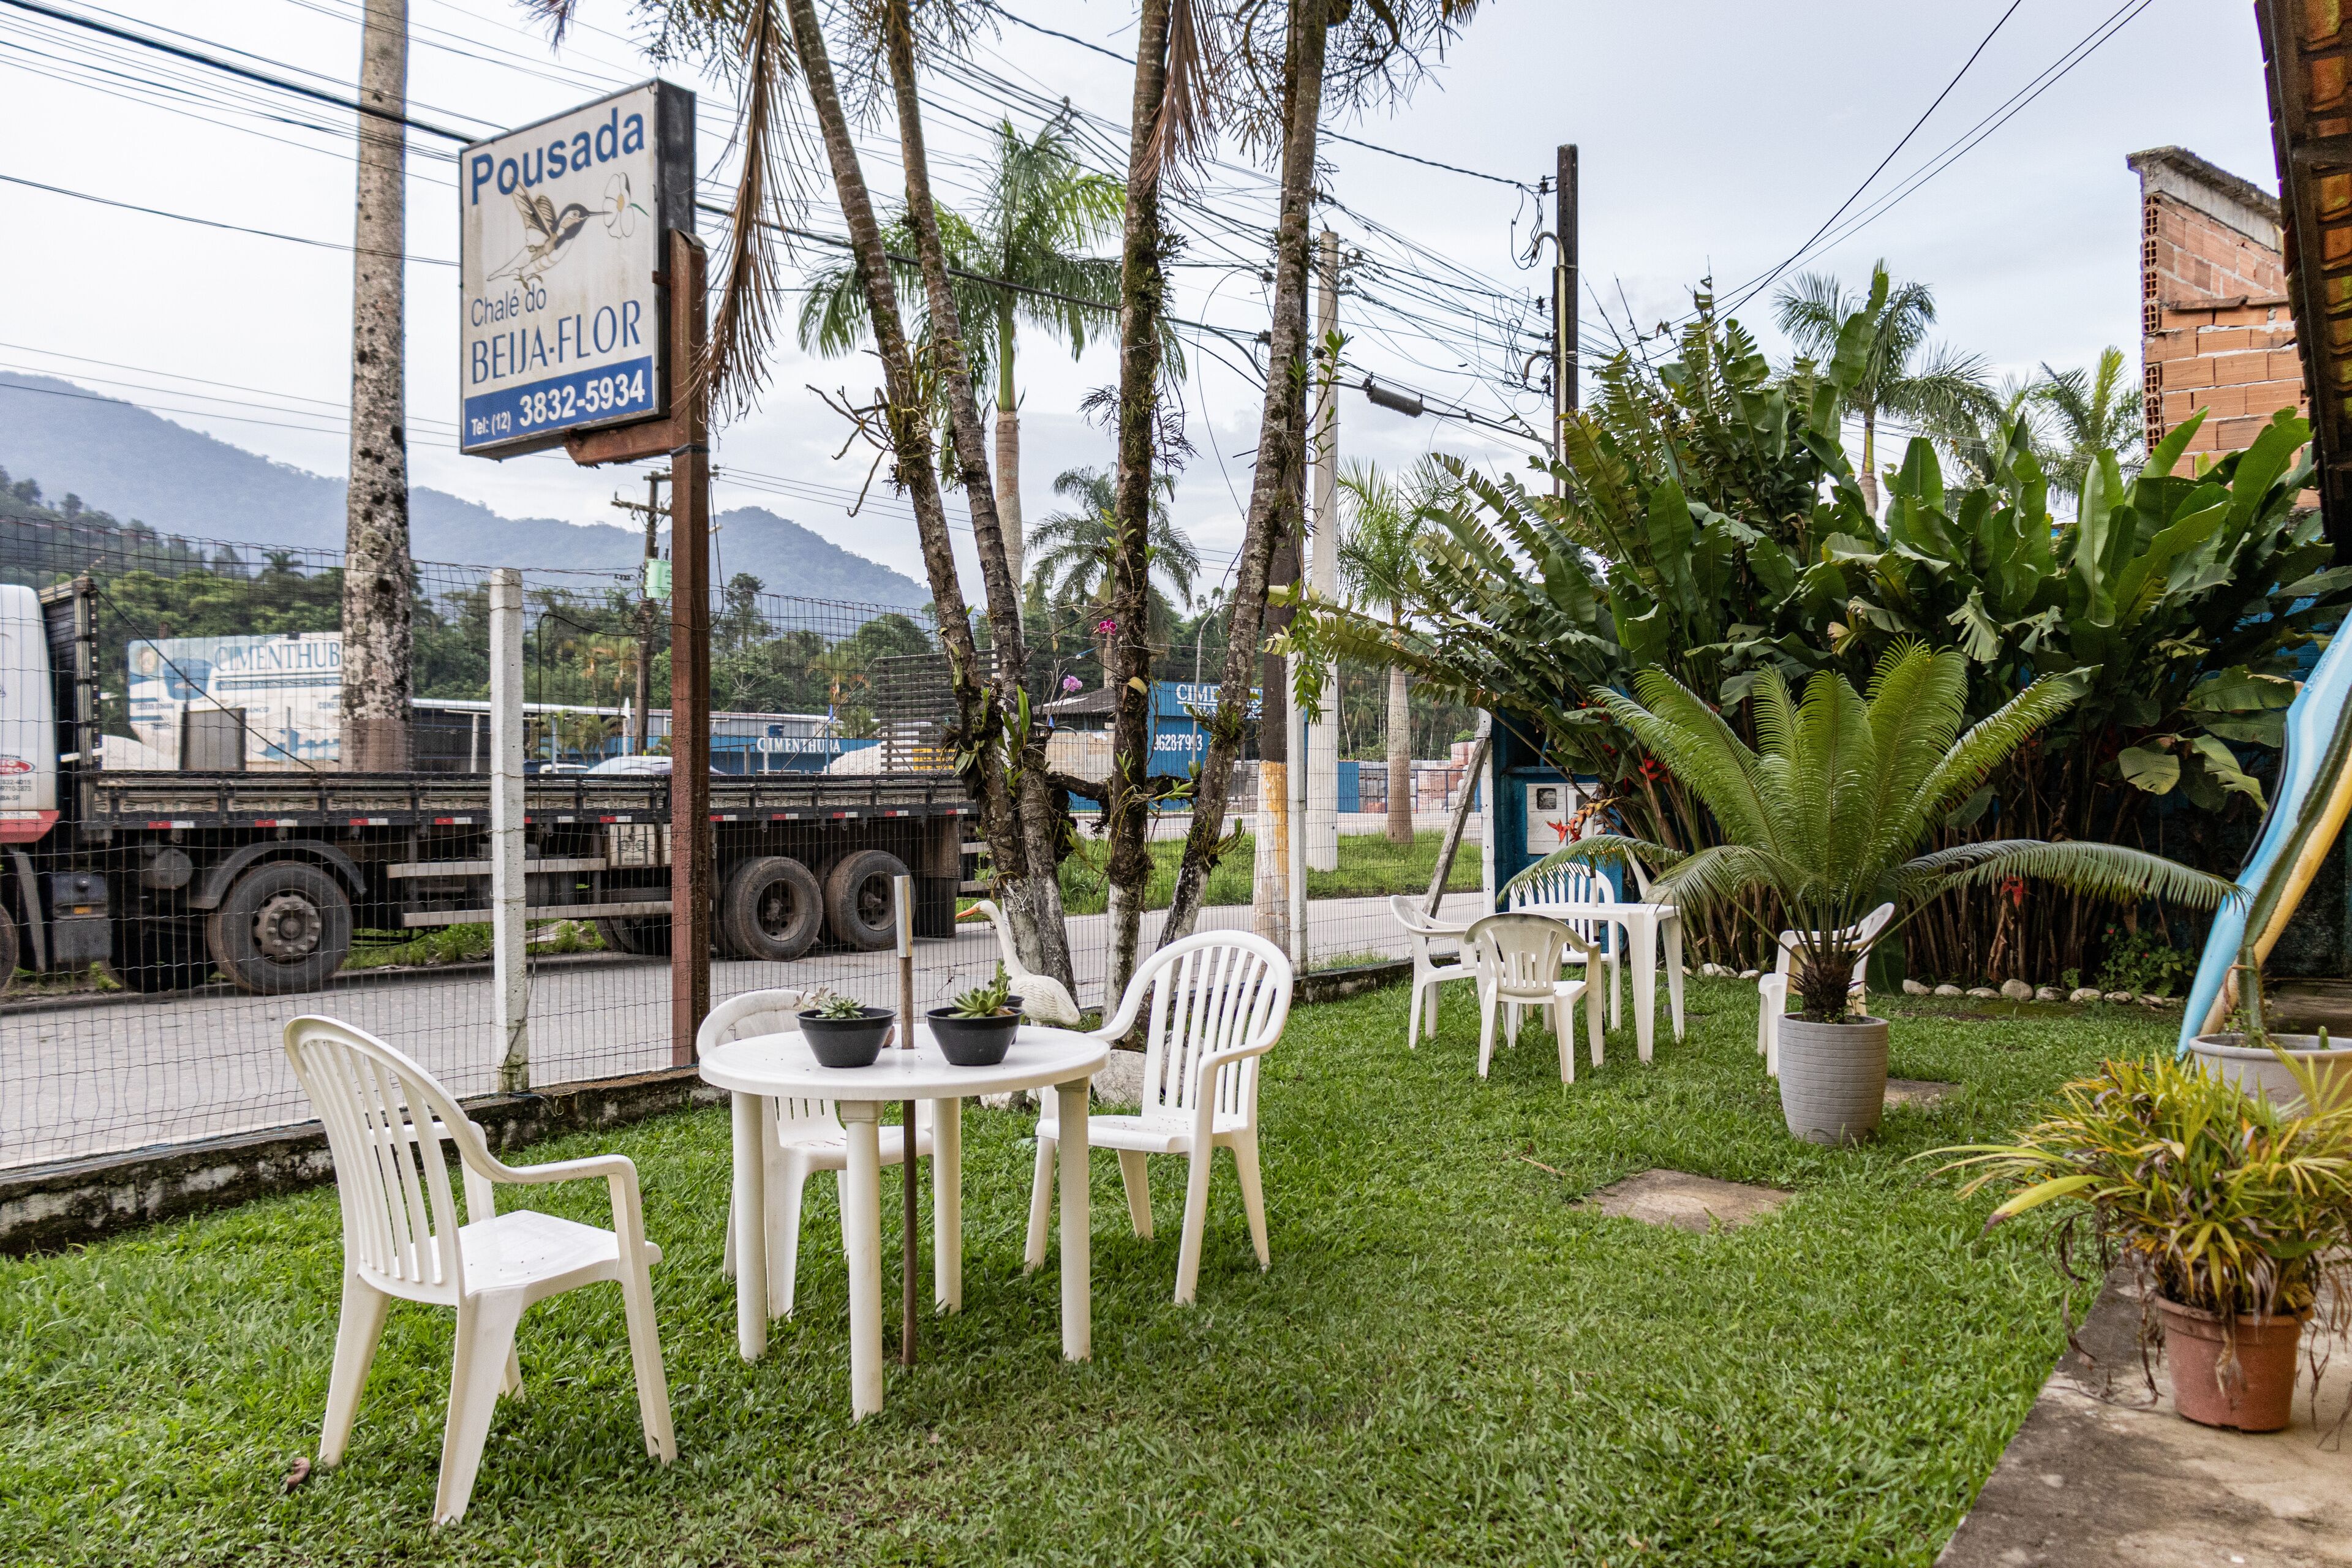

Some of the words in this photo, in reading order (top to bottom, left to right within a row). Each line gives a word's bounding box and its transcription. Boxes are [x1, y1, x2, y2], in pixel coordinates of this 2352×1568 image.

[471, 107, 646, 206] Pousada
[471, 288, 519, 327] Chalé
[525, 283, 547, 313] do
[472, 300, 641, 385] BEIJA-FLOR
[471, 417, 489, 436] Tel:
[491, 410, 511, 436] (12)
[519, 369, 645, 427] 3832-5934
[214, 642, 341, 672] CIMENTHUB
